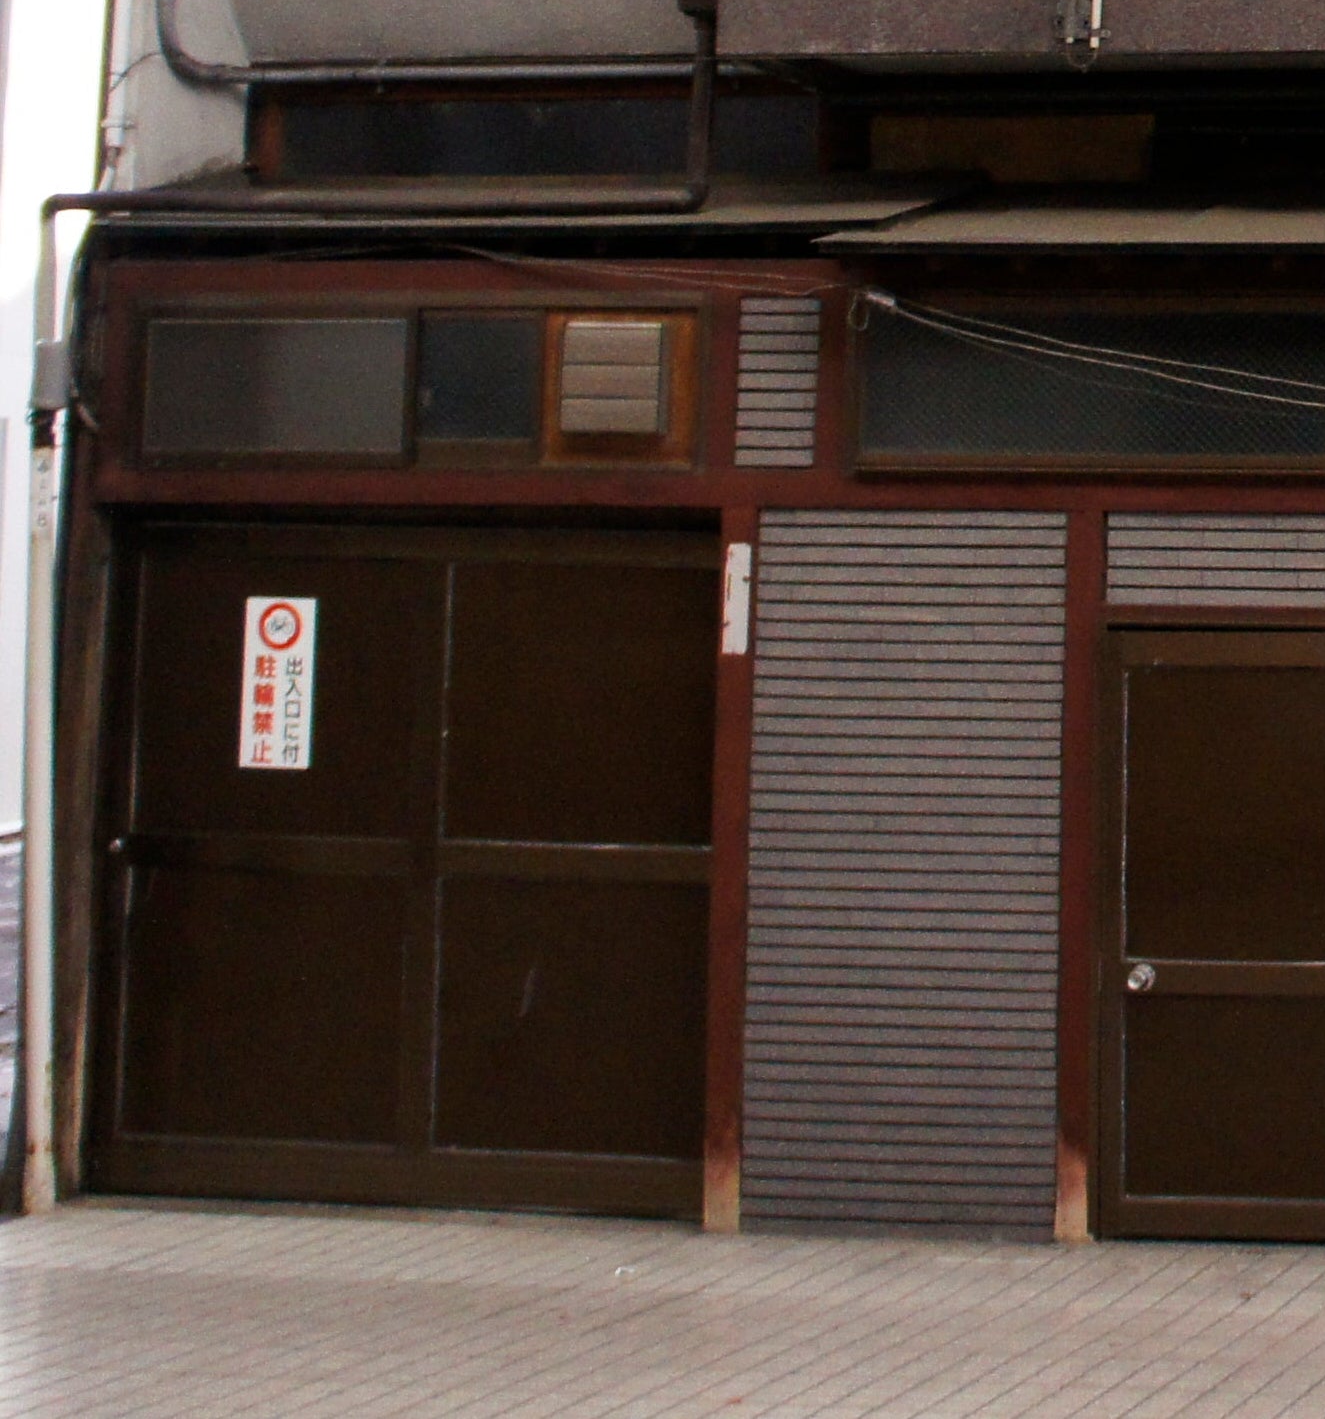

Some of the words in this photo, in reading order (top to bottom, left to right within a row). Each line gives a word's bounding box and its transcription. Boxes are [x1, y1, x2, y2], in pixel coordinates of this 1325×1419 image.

[251, 654, 277, 764] 駐輪禁止
[282, 655, 303, 764] 出入口に付
